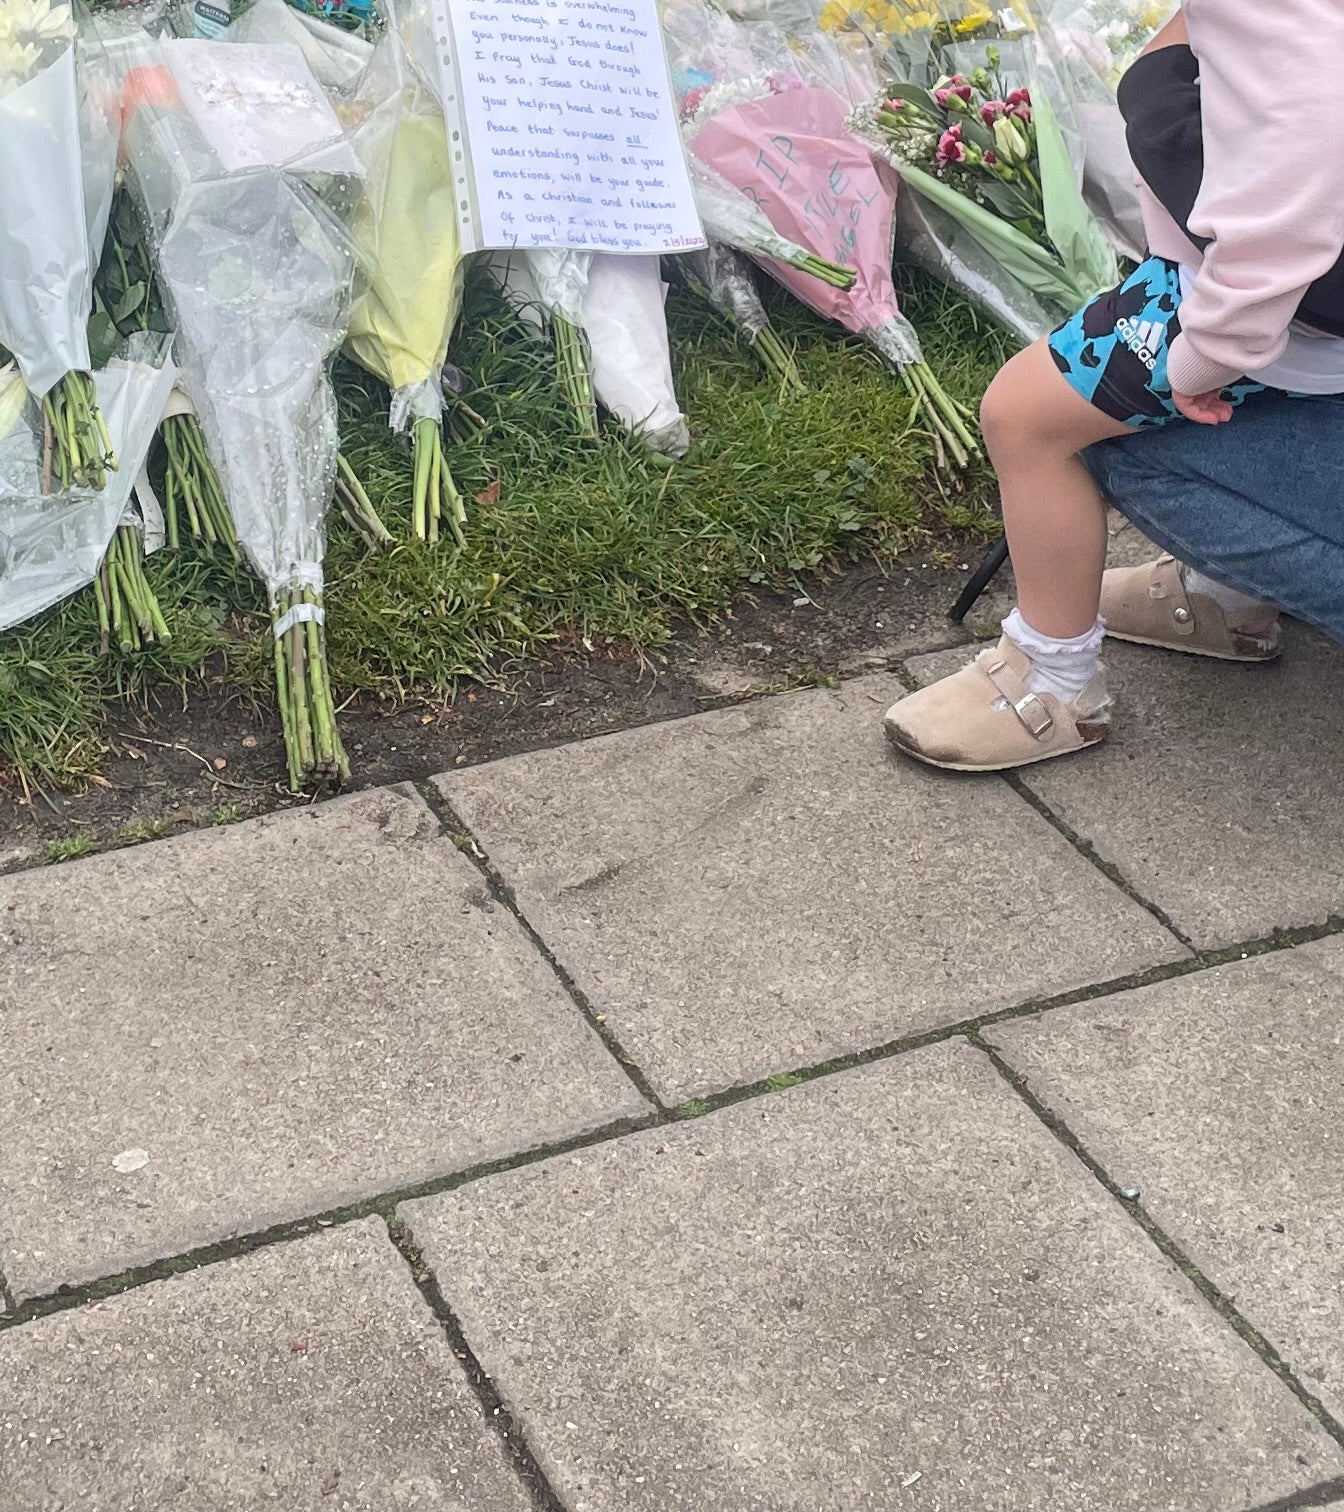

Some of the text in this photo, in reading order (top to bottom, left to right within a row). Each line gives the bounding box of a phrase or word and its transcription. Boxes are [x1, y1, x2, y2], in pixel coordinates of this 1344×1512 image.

[546, 0, 558, 8] is
[469, 11, 499, 22] Even
[511, 13, 550, 29] though
[558, 18, 569, 26] I
[578, 18, 593, 30] do
[595, 21, 615, 33] not
[471, 30, 494, 44] you
[567, 36, 601, 49] Jesus
[605, 41, 635, 55] does!
[474, 50, 486, 60] I
[530, 53, 557, 65] that
[568, 56, 592, 69] God
[599, 59, 641, 78] through
[477, 72, 496, 84] His
[539, 76, 573, 89] Jesus
[579, 79, 613, 93] Christ
[619, 84, 642, 96] will
[645, 87, 660, 99] be
[482, 95, 507, 112] your
[517, 96, 563, 116] helping
[566, 100, 594, 114] hand
[600, 106, 623, 117] and
[528, 123, 555, 135] that
[491, 146, 665, 171] understanding with all your
[560, 171, 582, 183] will
[589, 173, 603, 184] be
[608, 176, 630, 188] your
[497, 190, 513, 200] As
[523, 192, 535, 202] a
[600, 196, 622, 208] and
[568, 216, 577, 225] I
[583, 217, 609, 229] will
[615, 218, 628, 230] be
[633, 222, 673, 236] praying
[566, 230, 588, 245] God
[590, 232, 620, 247] bless
